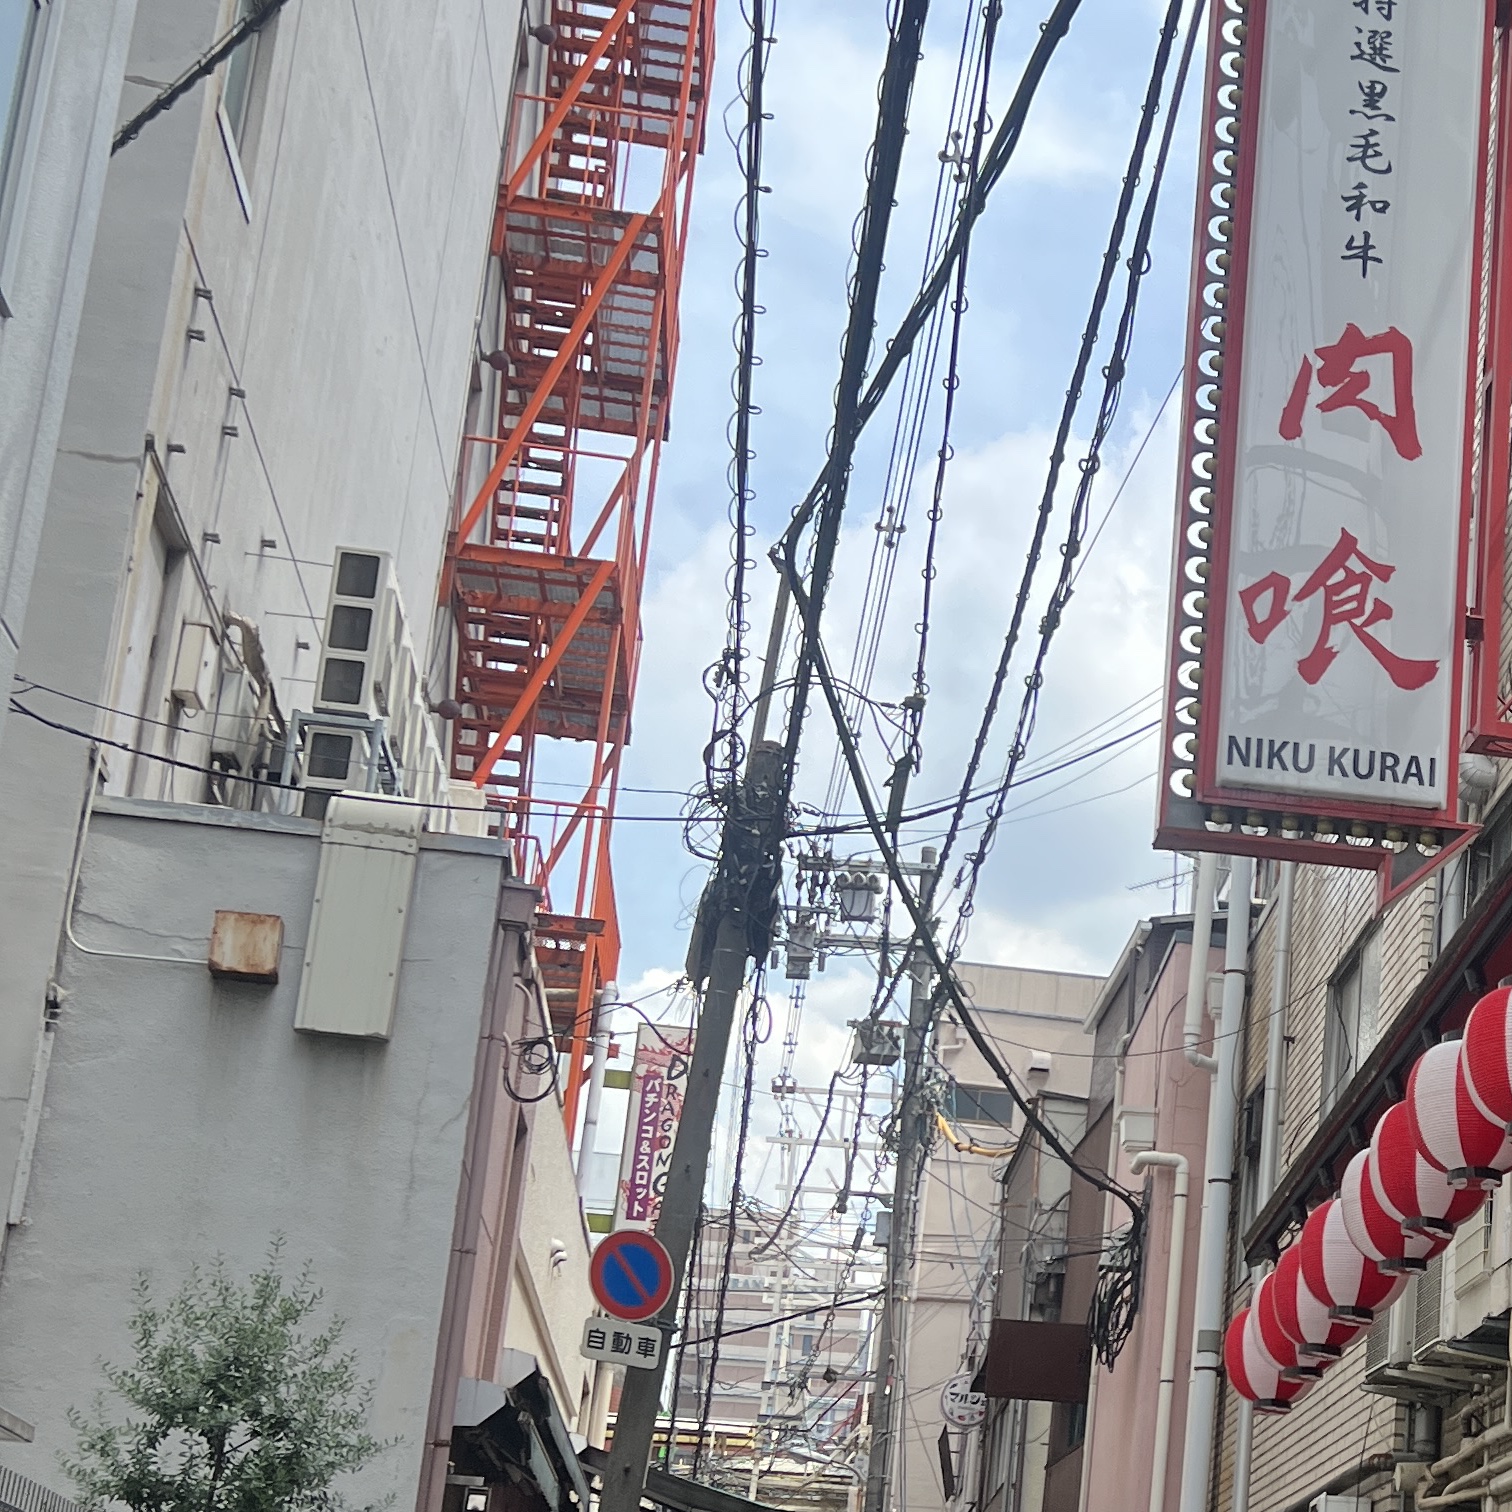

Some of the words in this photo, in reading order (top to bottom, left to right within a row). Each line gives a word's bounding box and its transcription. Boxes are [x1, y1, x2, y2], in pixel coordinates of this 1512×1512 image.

[1239, 322, 1440, 690] 肉喰
[1227, 735, 1316, 774] NIKU
[1327, 746, 1437, 789] KURAI
[632, 1078, 662, 1218] パチンコ&スロット
[587, 1328, 658, 1359] 自動車
